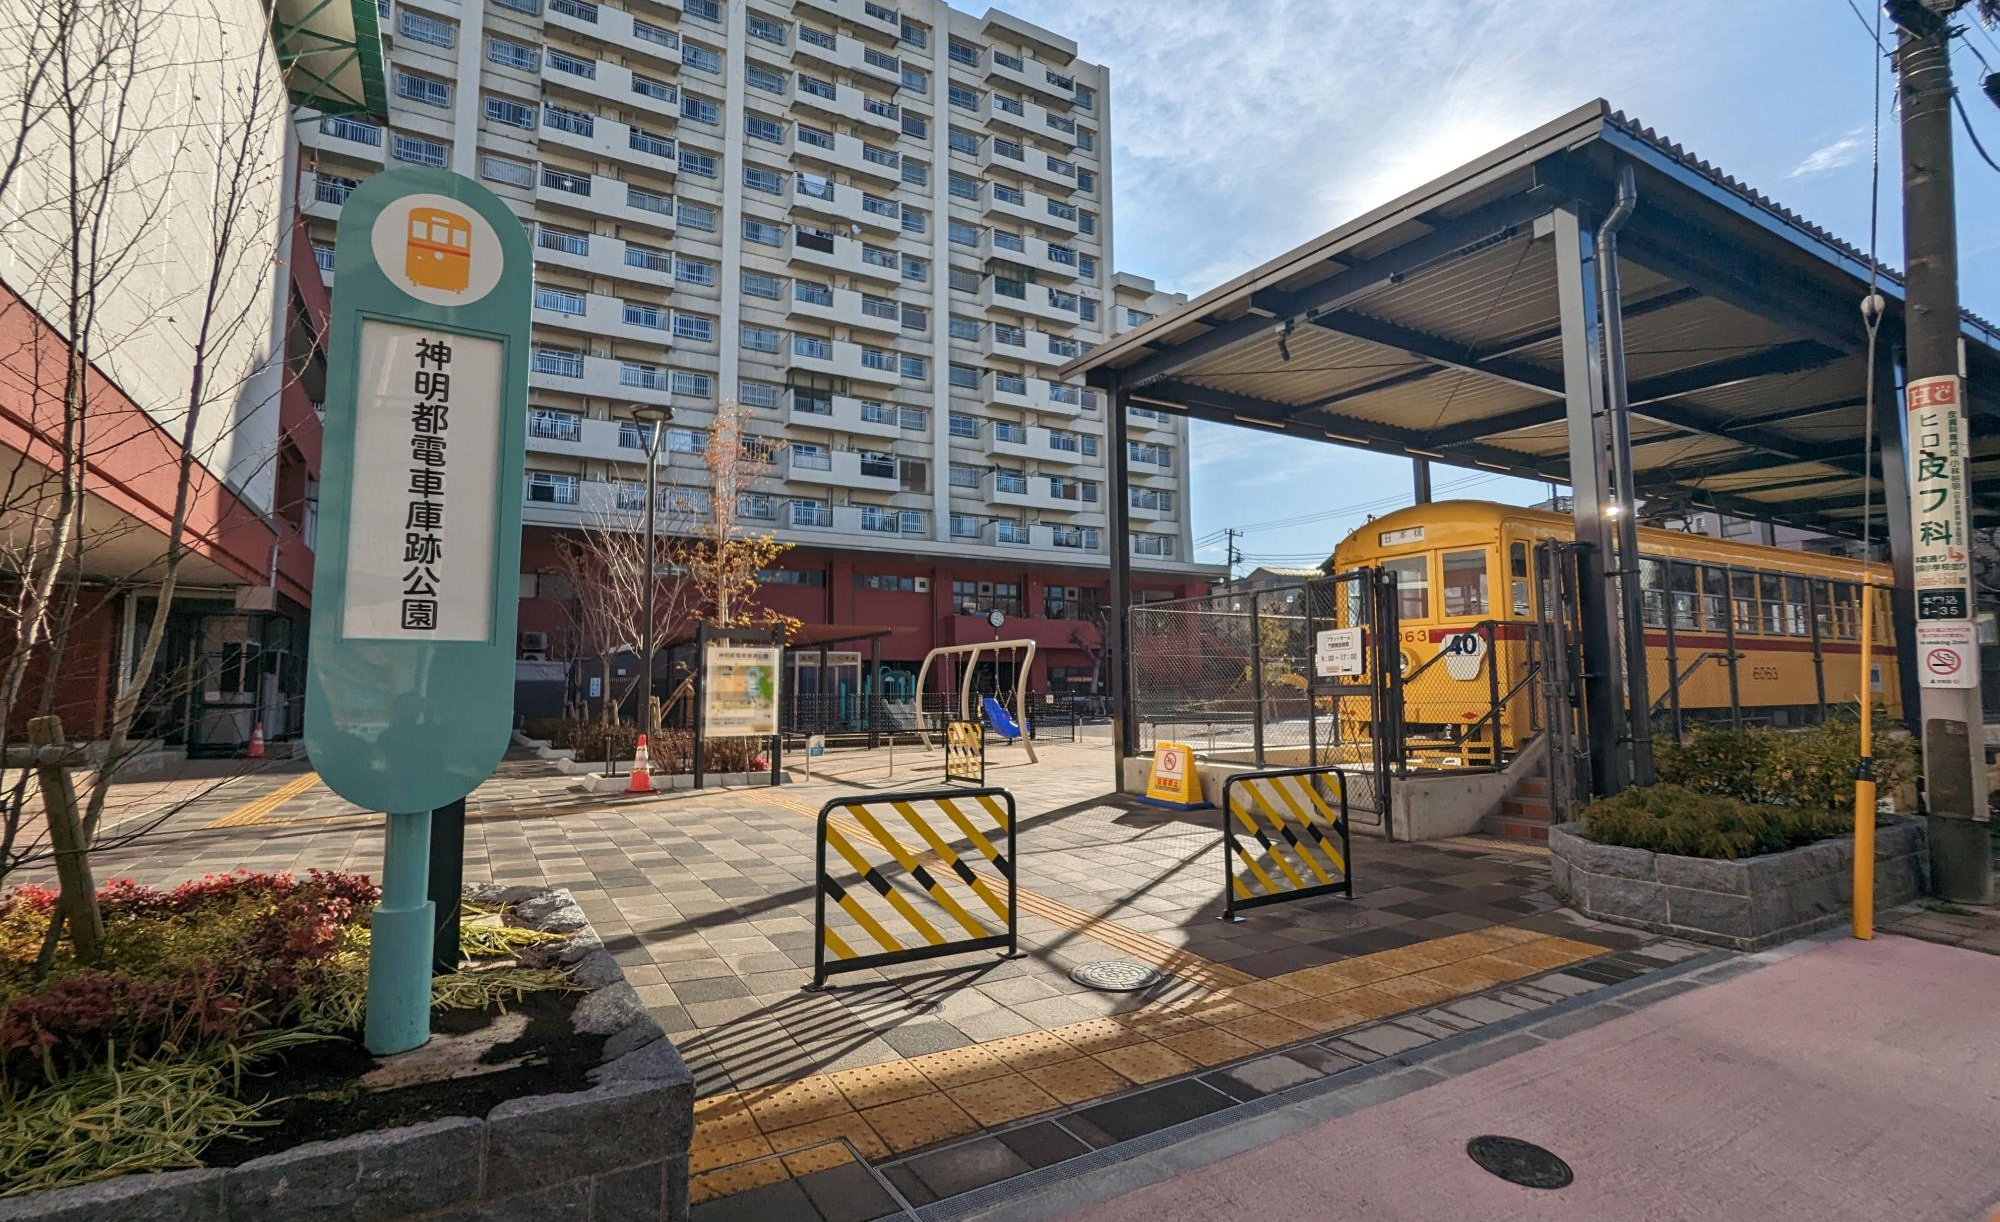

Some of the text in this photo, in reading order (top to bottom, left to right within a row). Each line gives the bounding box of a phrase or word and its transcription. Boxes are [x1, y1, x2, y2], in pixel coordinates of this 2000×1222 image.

[400, 337, 452, 631] 神明都電車庫跡公園
[1450, 634, 1477, 655] 40
